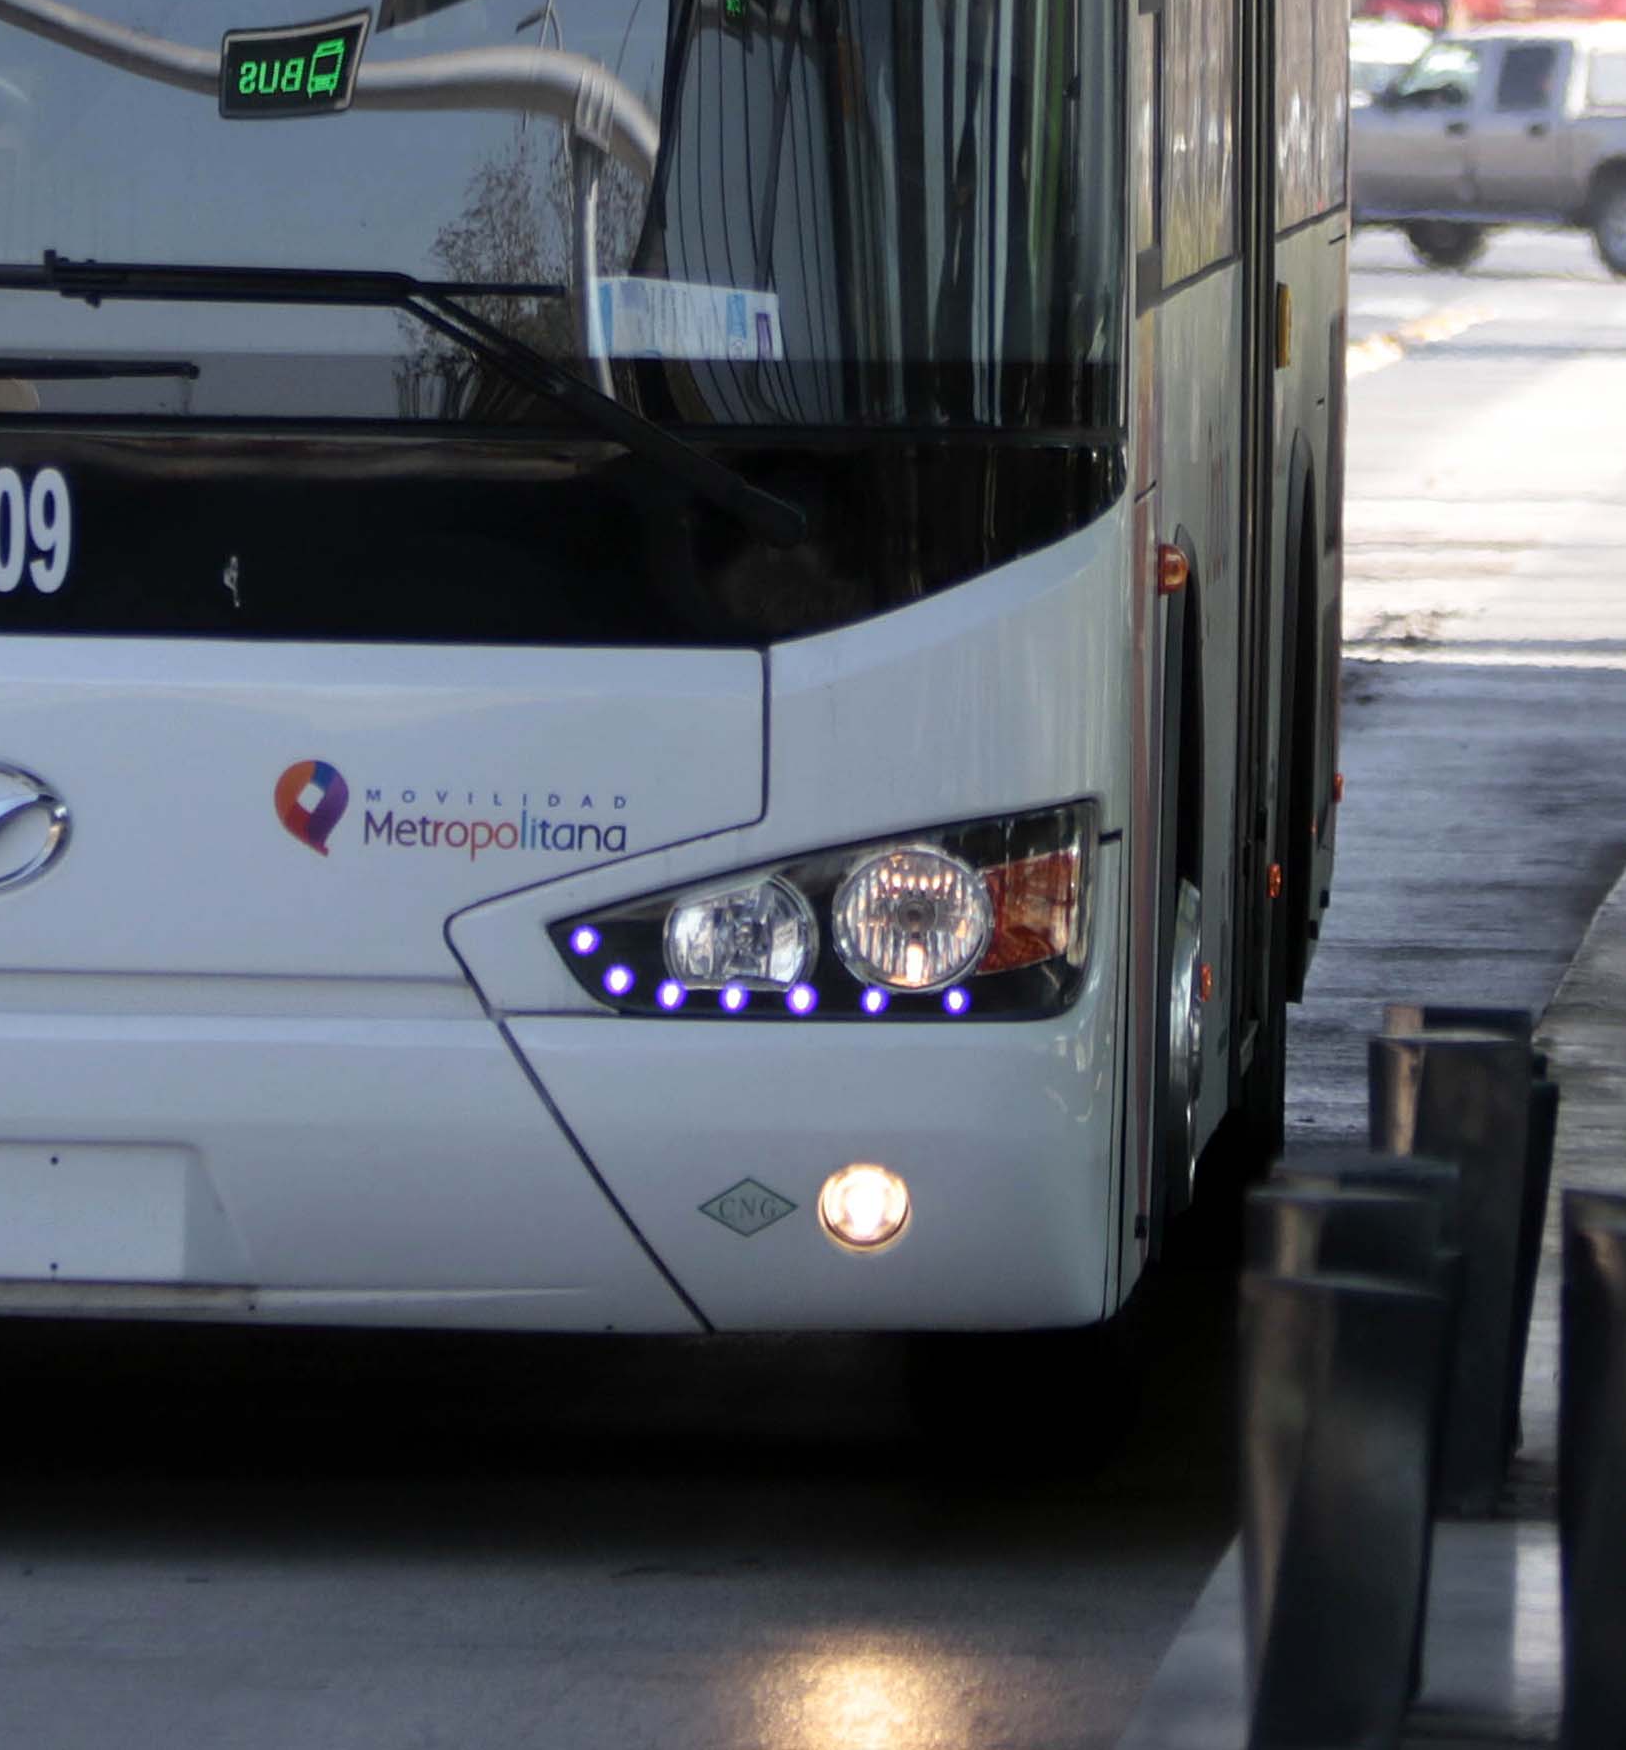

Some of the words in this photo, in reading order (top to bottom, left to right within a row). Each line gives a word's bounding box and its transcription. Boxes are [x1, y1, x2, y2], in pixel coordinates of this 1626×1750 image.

[366, 788, 628, 810] MOVILIDAD
[364, 810, 628, 862] Metropolitana
[717, 1196, 777, 1220] CNG
